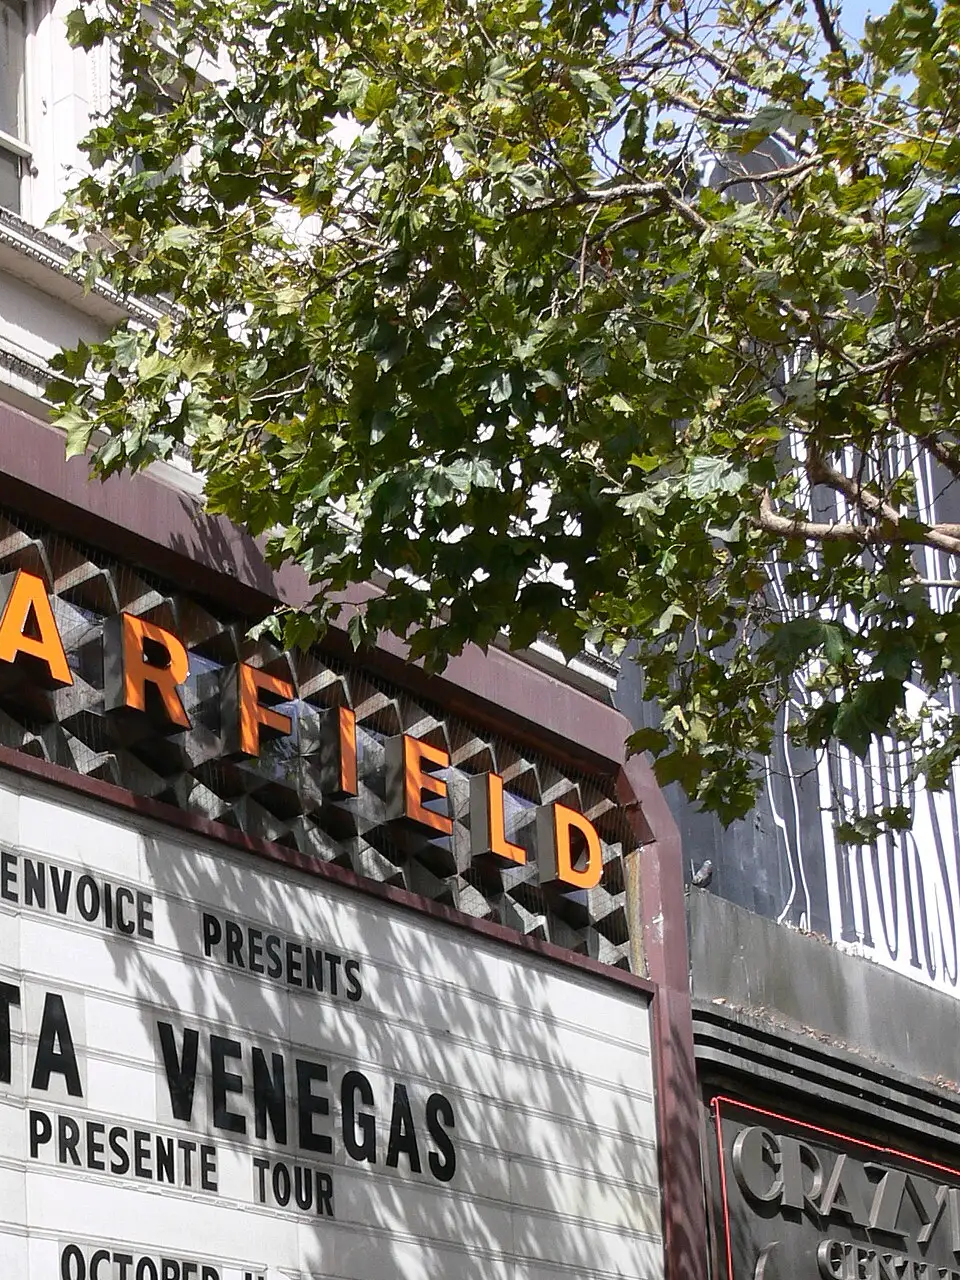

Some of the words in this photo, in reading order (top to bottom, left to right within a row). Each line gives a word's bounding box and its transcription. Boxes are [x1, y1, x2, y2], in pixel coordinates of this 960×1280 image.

[203, 912, 363, 1001] PRESENTS
[156, 1020, 456, 1183] VENEGAS
[29, 1110, 218, 1192] PRESENTE
[252, 1157, 334, 1217] TOUR
[732, 1126, 948, 1243] CRAZY
